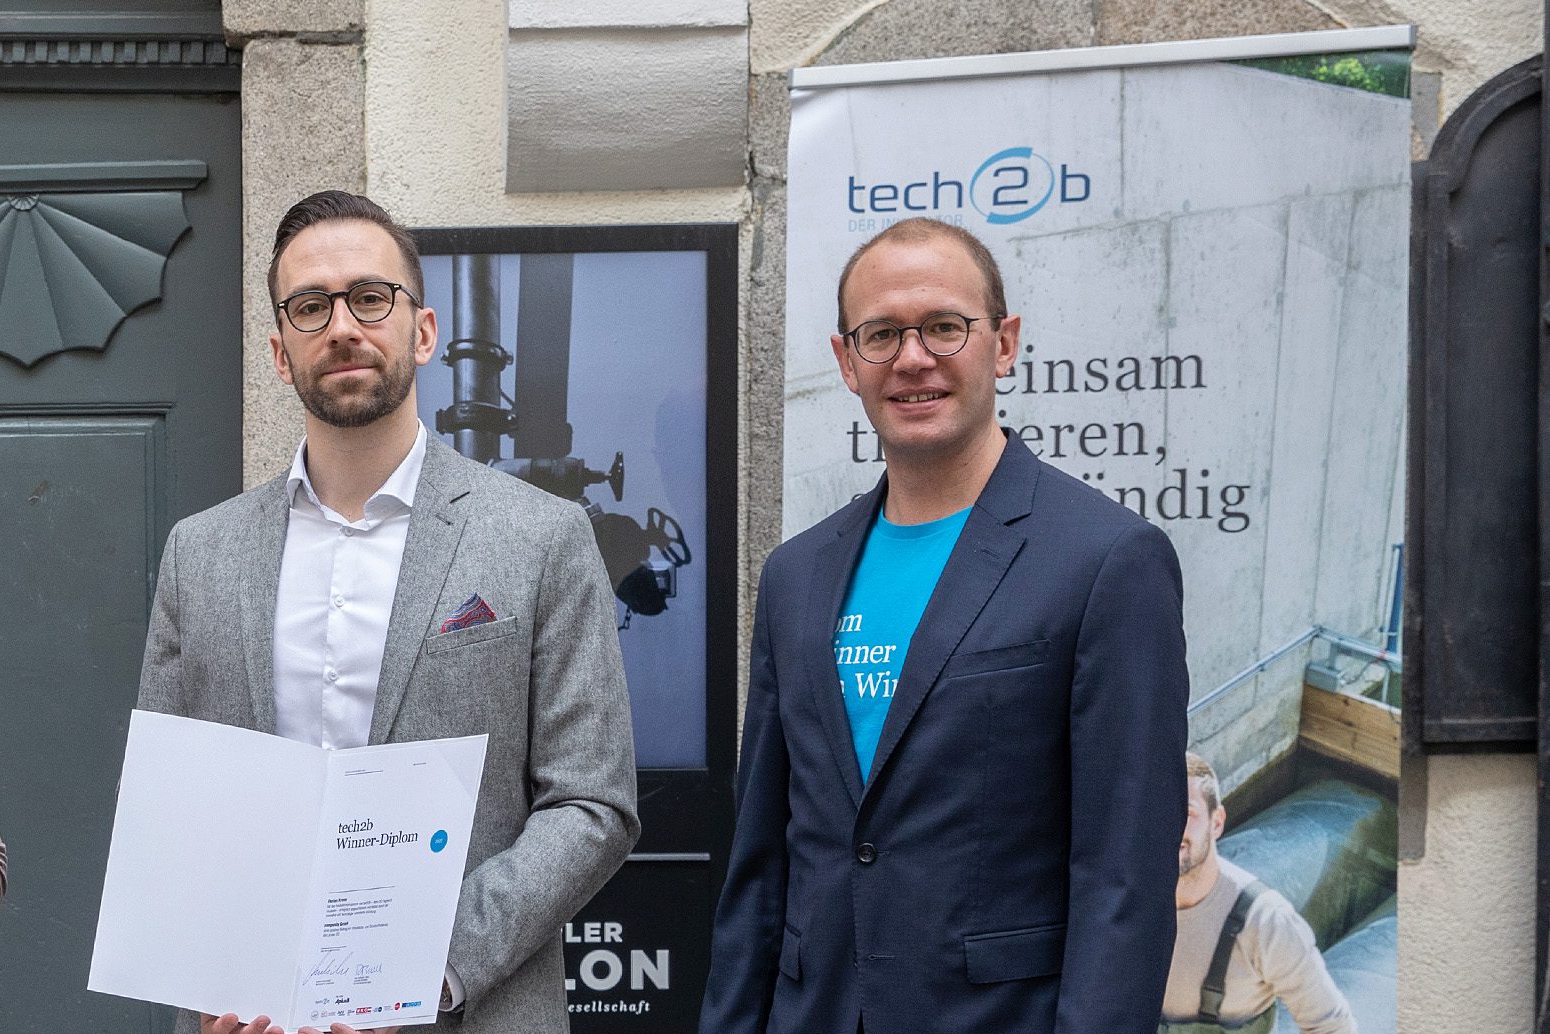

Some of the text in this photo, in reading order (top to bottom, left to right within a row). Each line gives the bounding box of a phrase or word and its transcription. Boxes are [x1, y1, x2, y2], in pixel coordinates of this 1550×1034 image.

[847, 162, 1091, 214] tech2b
[338, 818, 374, 834] tech2b
[336, 830, 418, 850] Winner-Diplom
[561, 922, 623, 943] LER
[565, 949, 670, 991] ON
